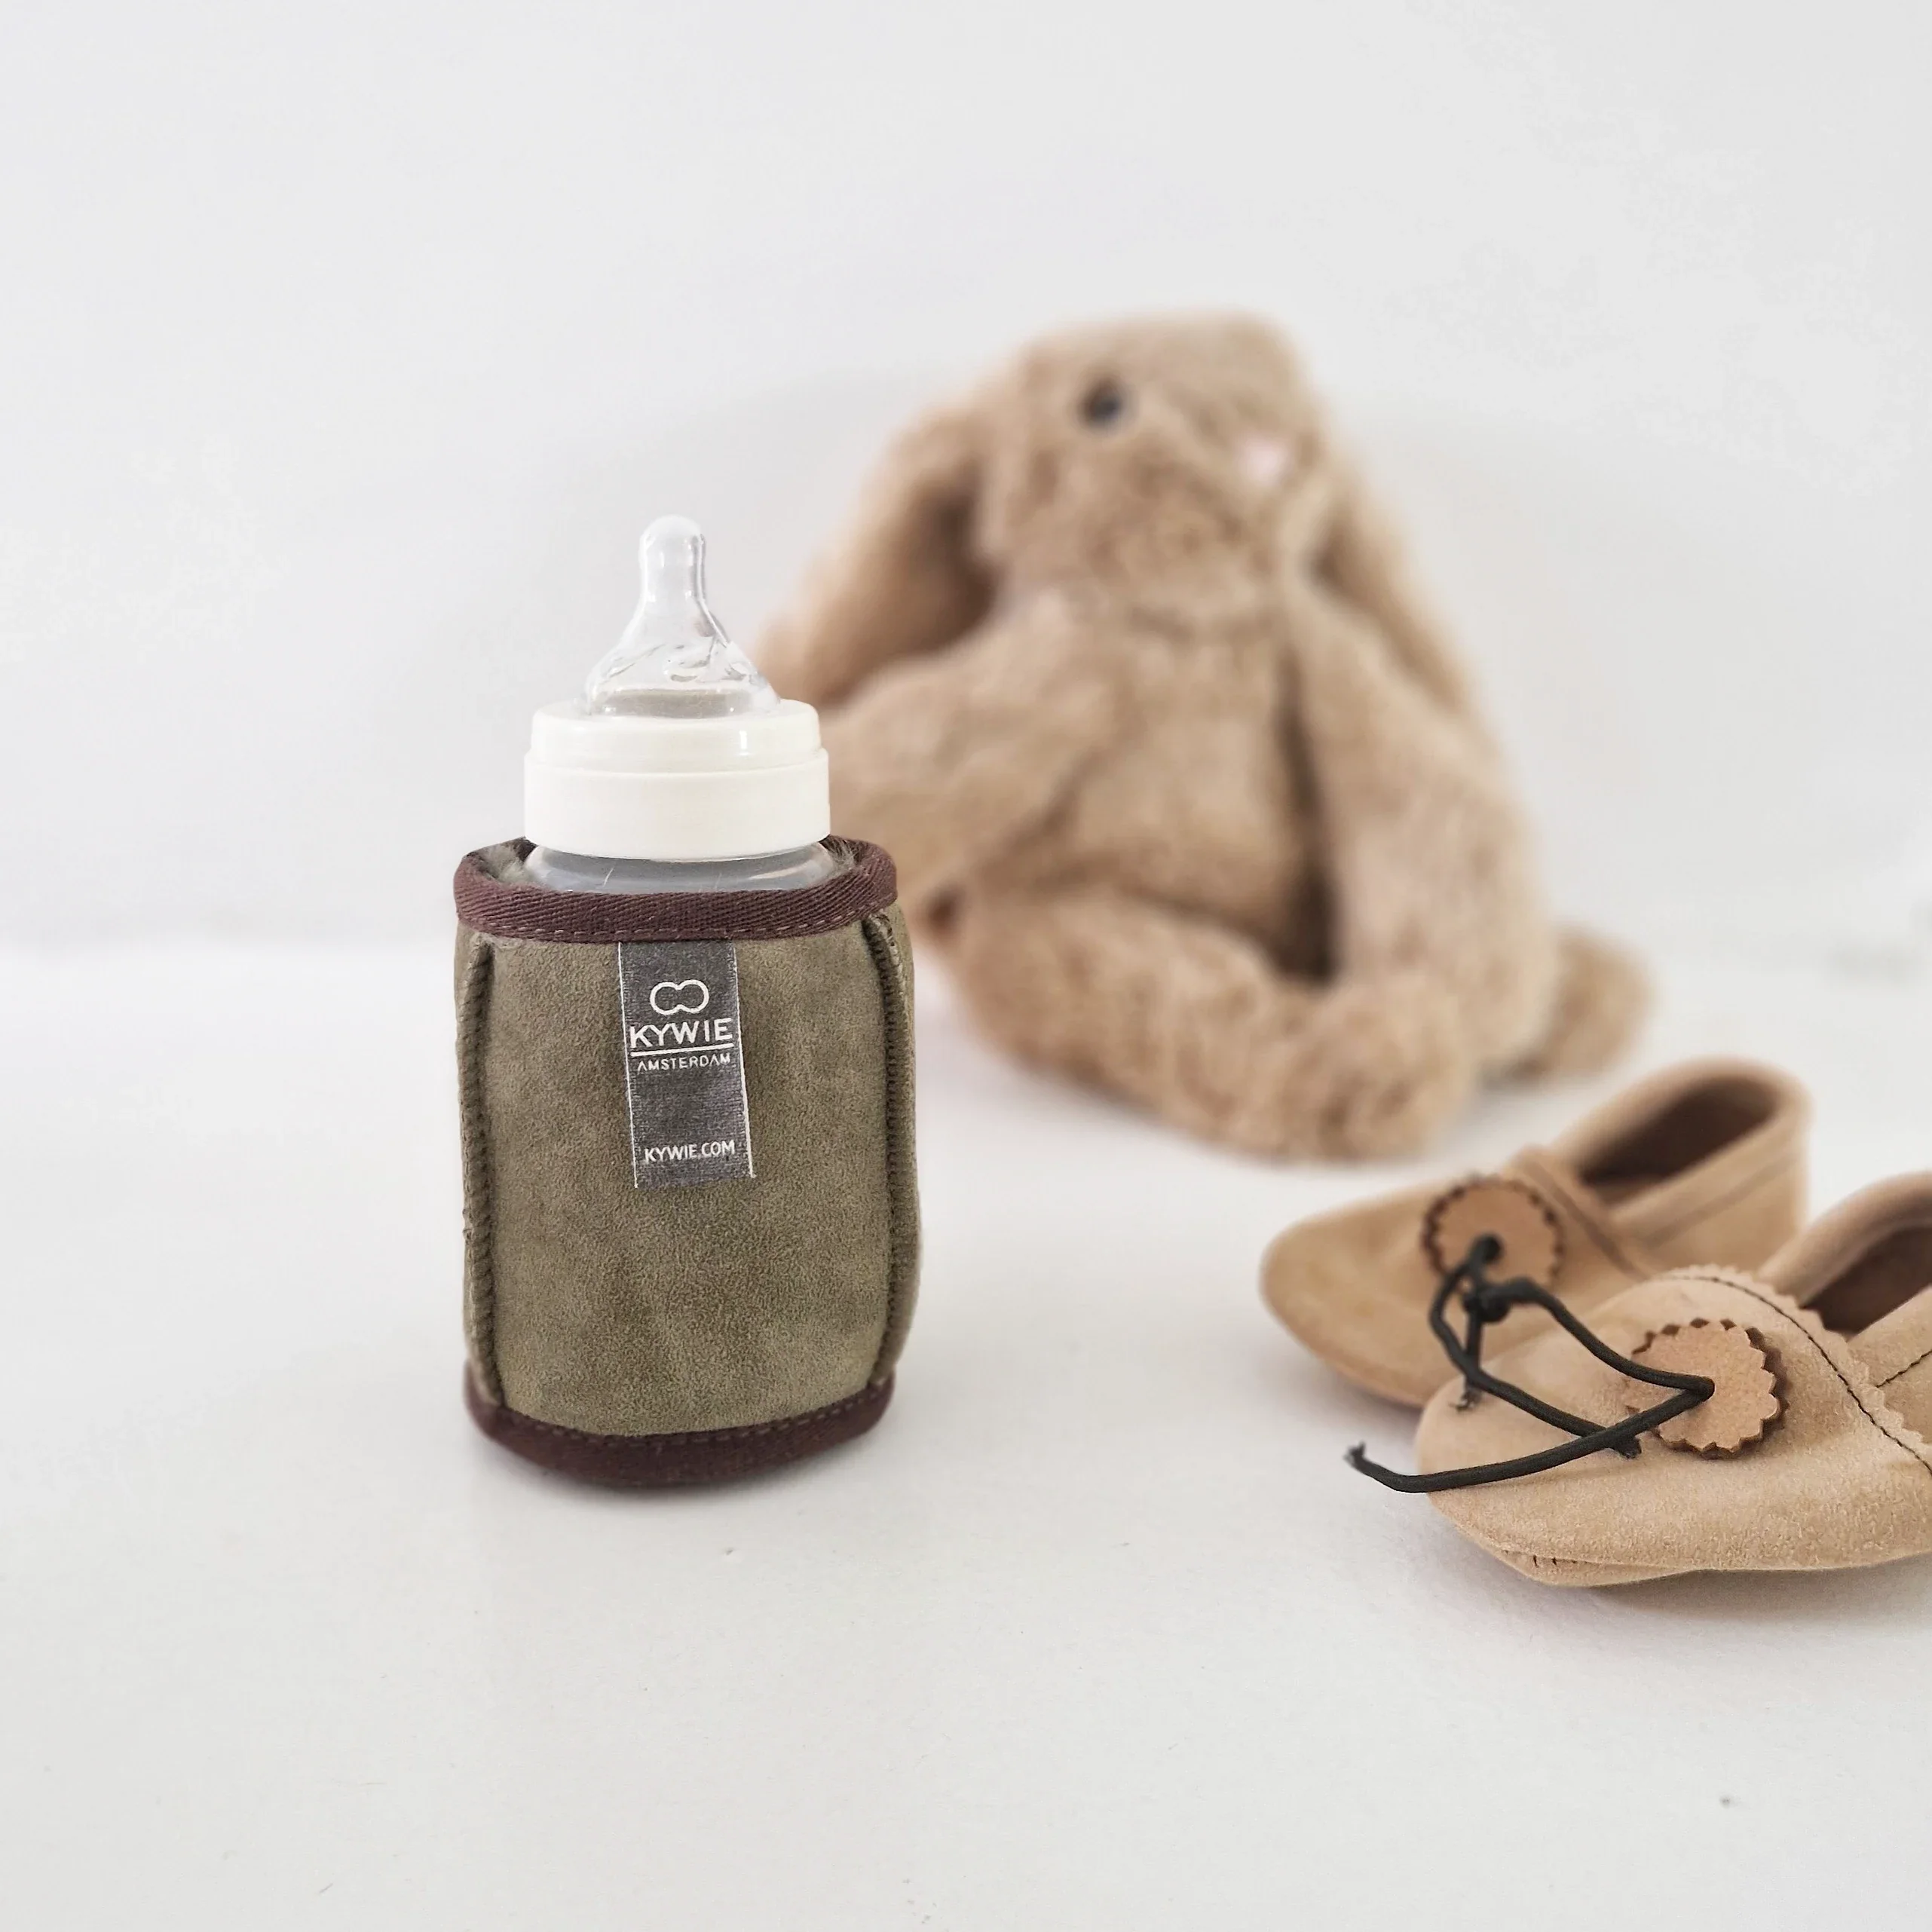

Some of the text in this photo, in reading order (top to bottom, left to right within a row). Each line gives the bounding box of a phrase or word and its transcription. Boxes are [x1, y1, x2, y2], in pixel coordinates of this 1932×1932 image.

[629, 1018, 733, 1049] KYWIE
[637, 1054, 730, 1070] AMSTERDAM
[645, 1140, 735, 1164] KYWIE.COM
